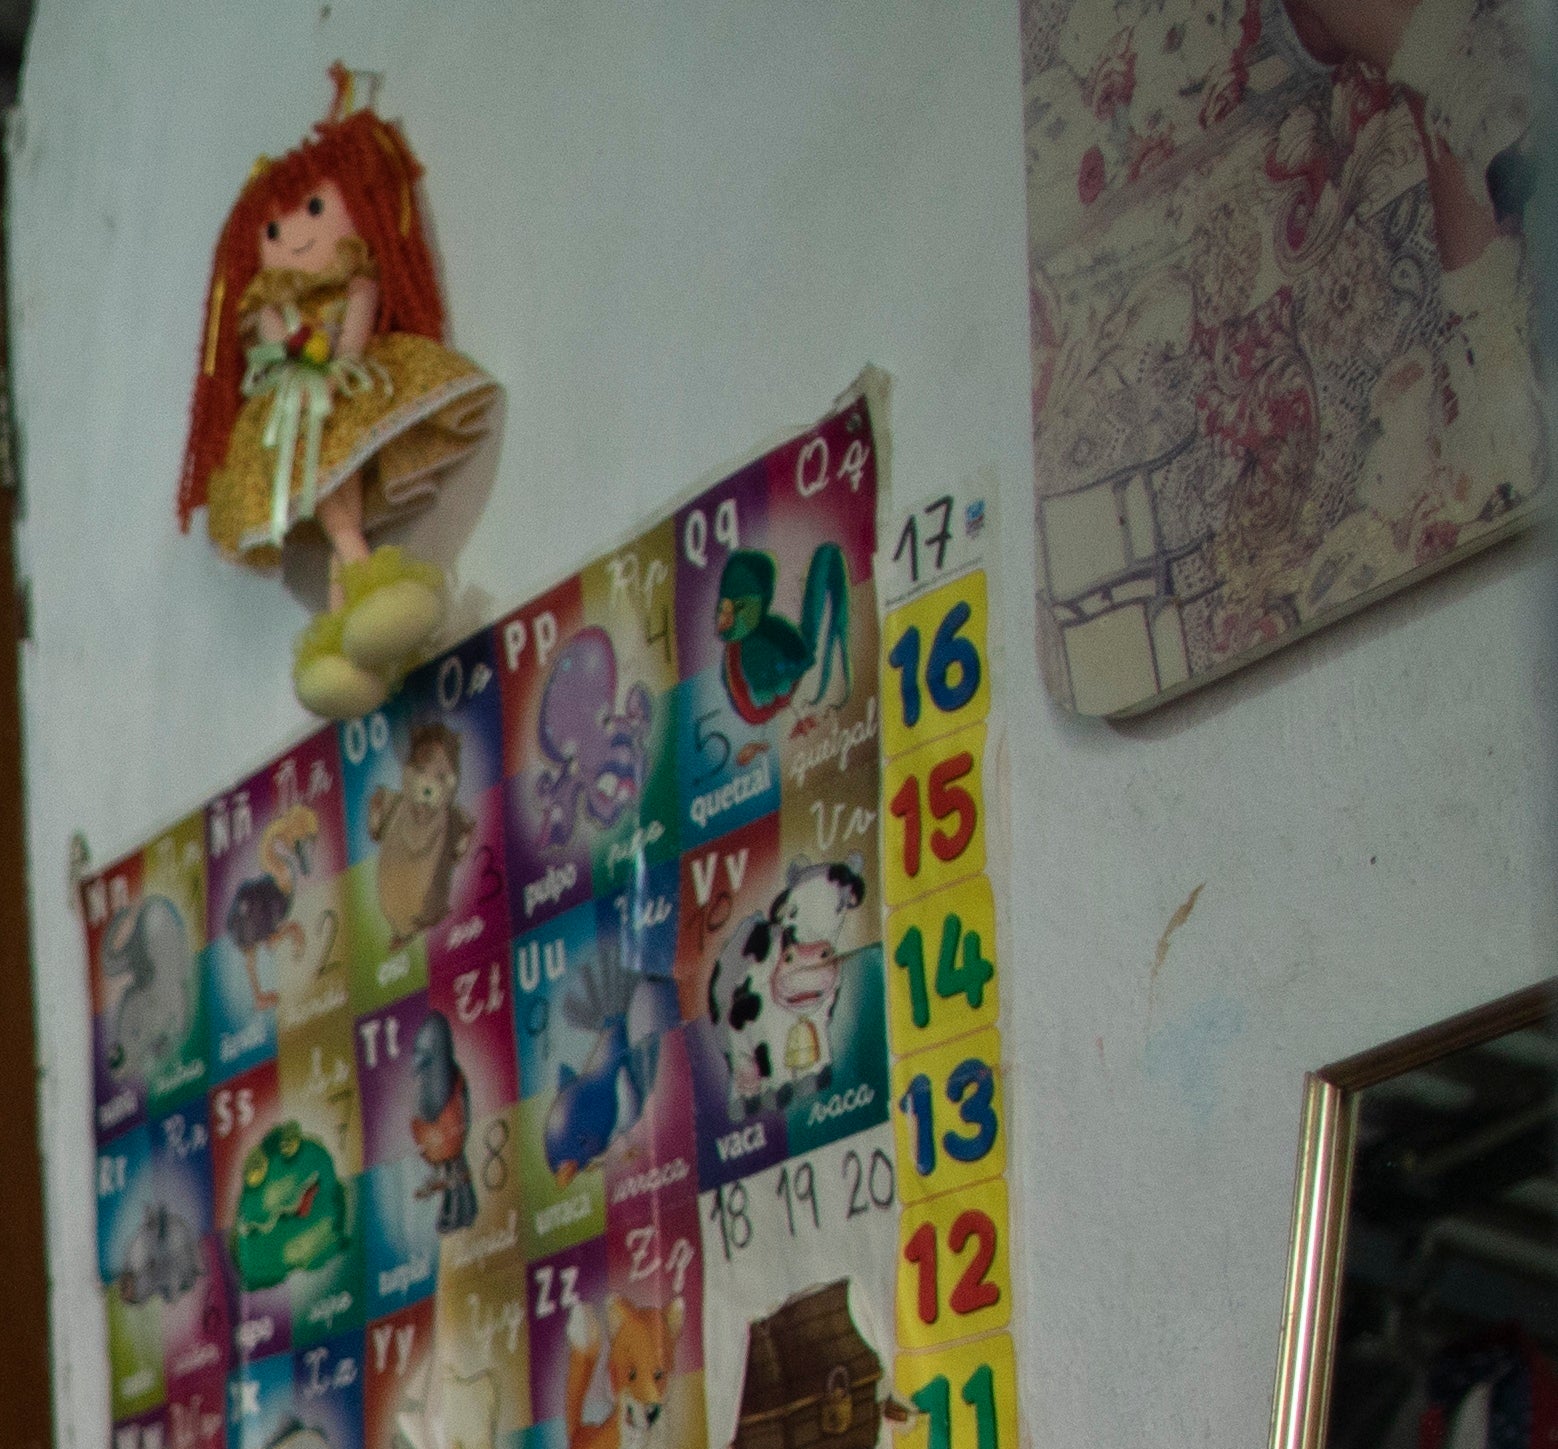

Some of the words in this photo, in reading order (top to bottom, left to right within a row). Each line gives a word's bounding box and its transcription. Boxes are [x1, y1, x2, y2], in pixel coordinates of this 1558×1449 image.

[893, 496, 954, 581] 17
[888, 601, 982, 727] 16
[690, 757, 772, 829] quetzal
[693, 708, 732, 786] 5
[889, 751, 977, 878] 15
[895, 912, 994, 1029] 14
[483, 1118, 510, 1191] 8
[716, 1123, 767, 1162] vaca
[900, 1057, 999, 1177] 13
[709, 1181, 753, 1263] 18
[777, 1161, 820, 1237] 19
[842, 1148, 897, 1220] 20
[903, 1208, 1001, 1326] 12
